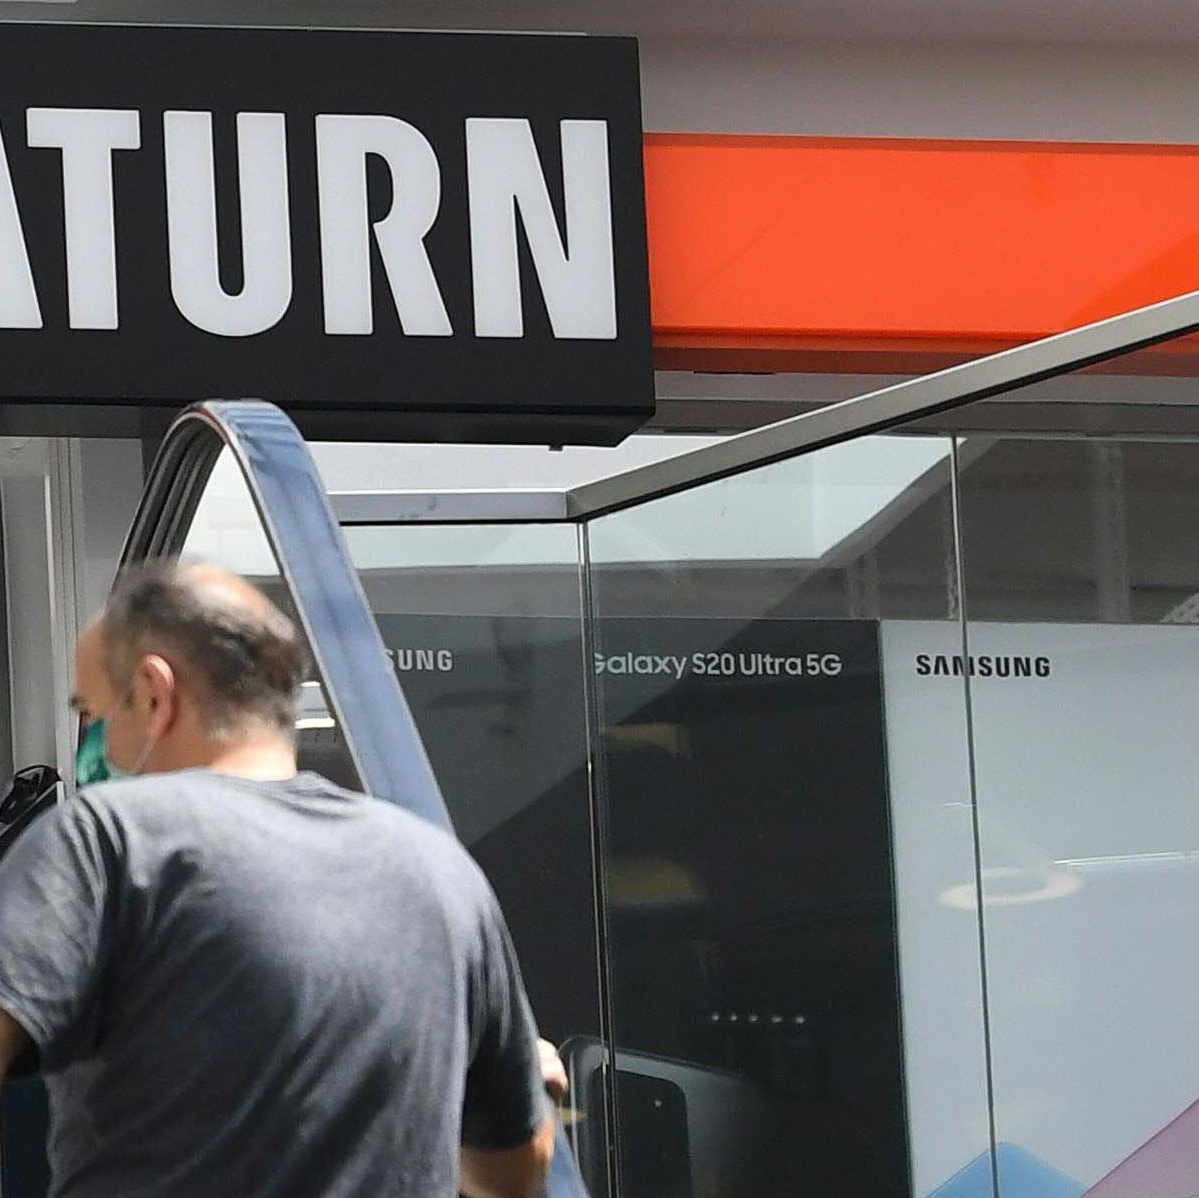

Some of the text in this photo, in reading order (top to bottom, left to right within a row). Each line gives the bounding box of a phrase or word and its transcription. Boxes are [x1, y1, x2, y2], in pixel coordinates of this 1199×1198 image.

[691, 652, 735, 676] S20
[738, 653, 803, 676] Ultra
[806, 653, 843, 676] 5G
[915, 654, 1051, 678] SAMSUNG
